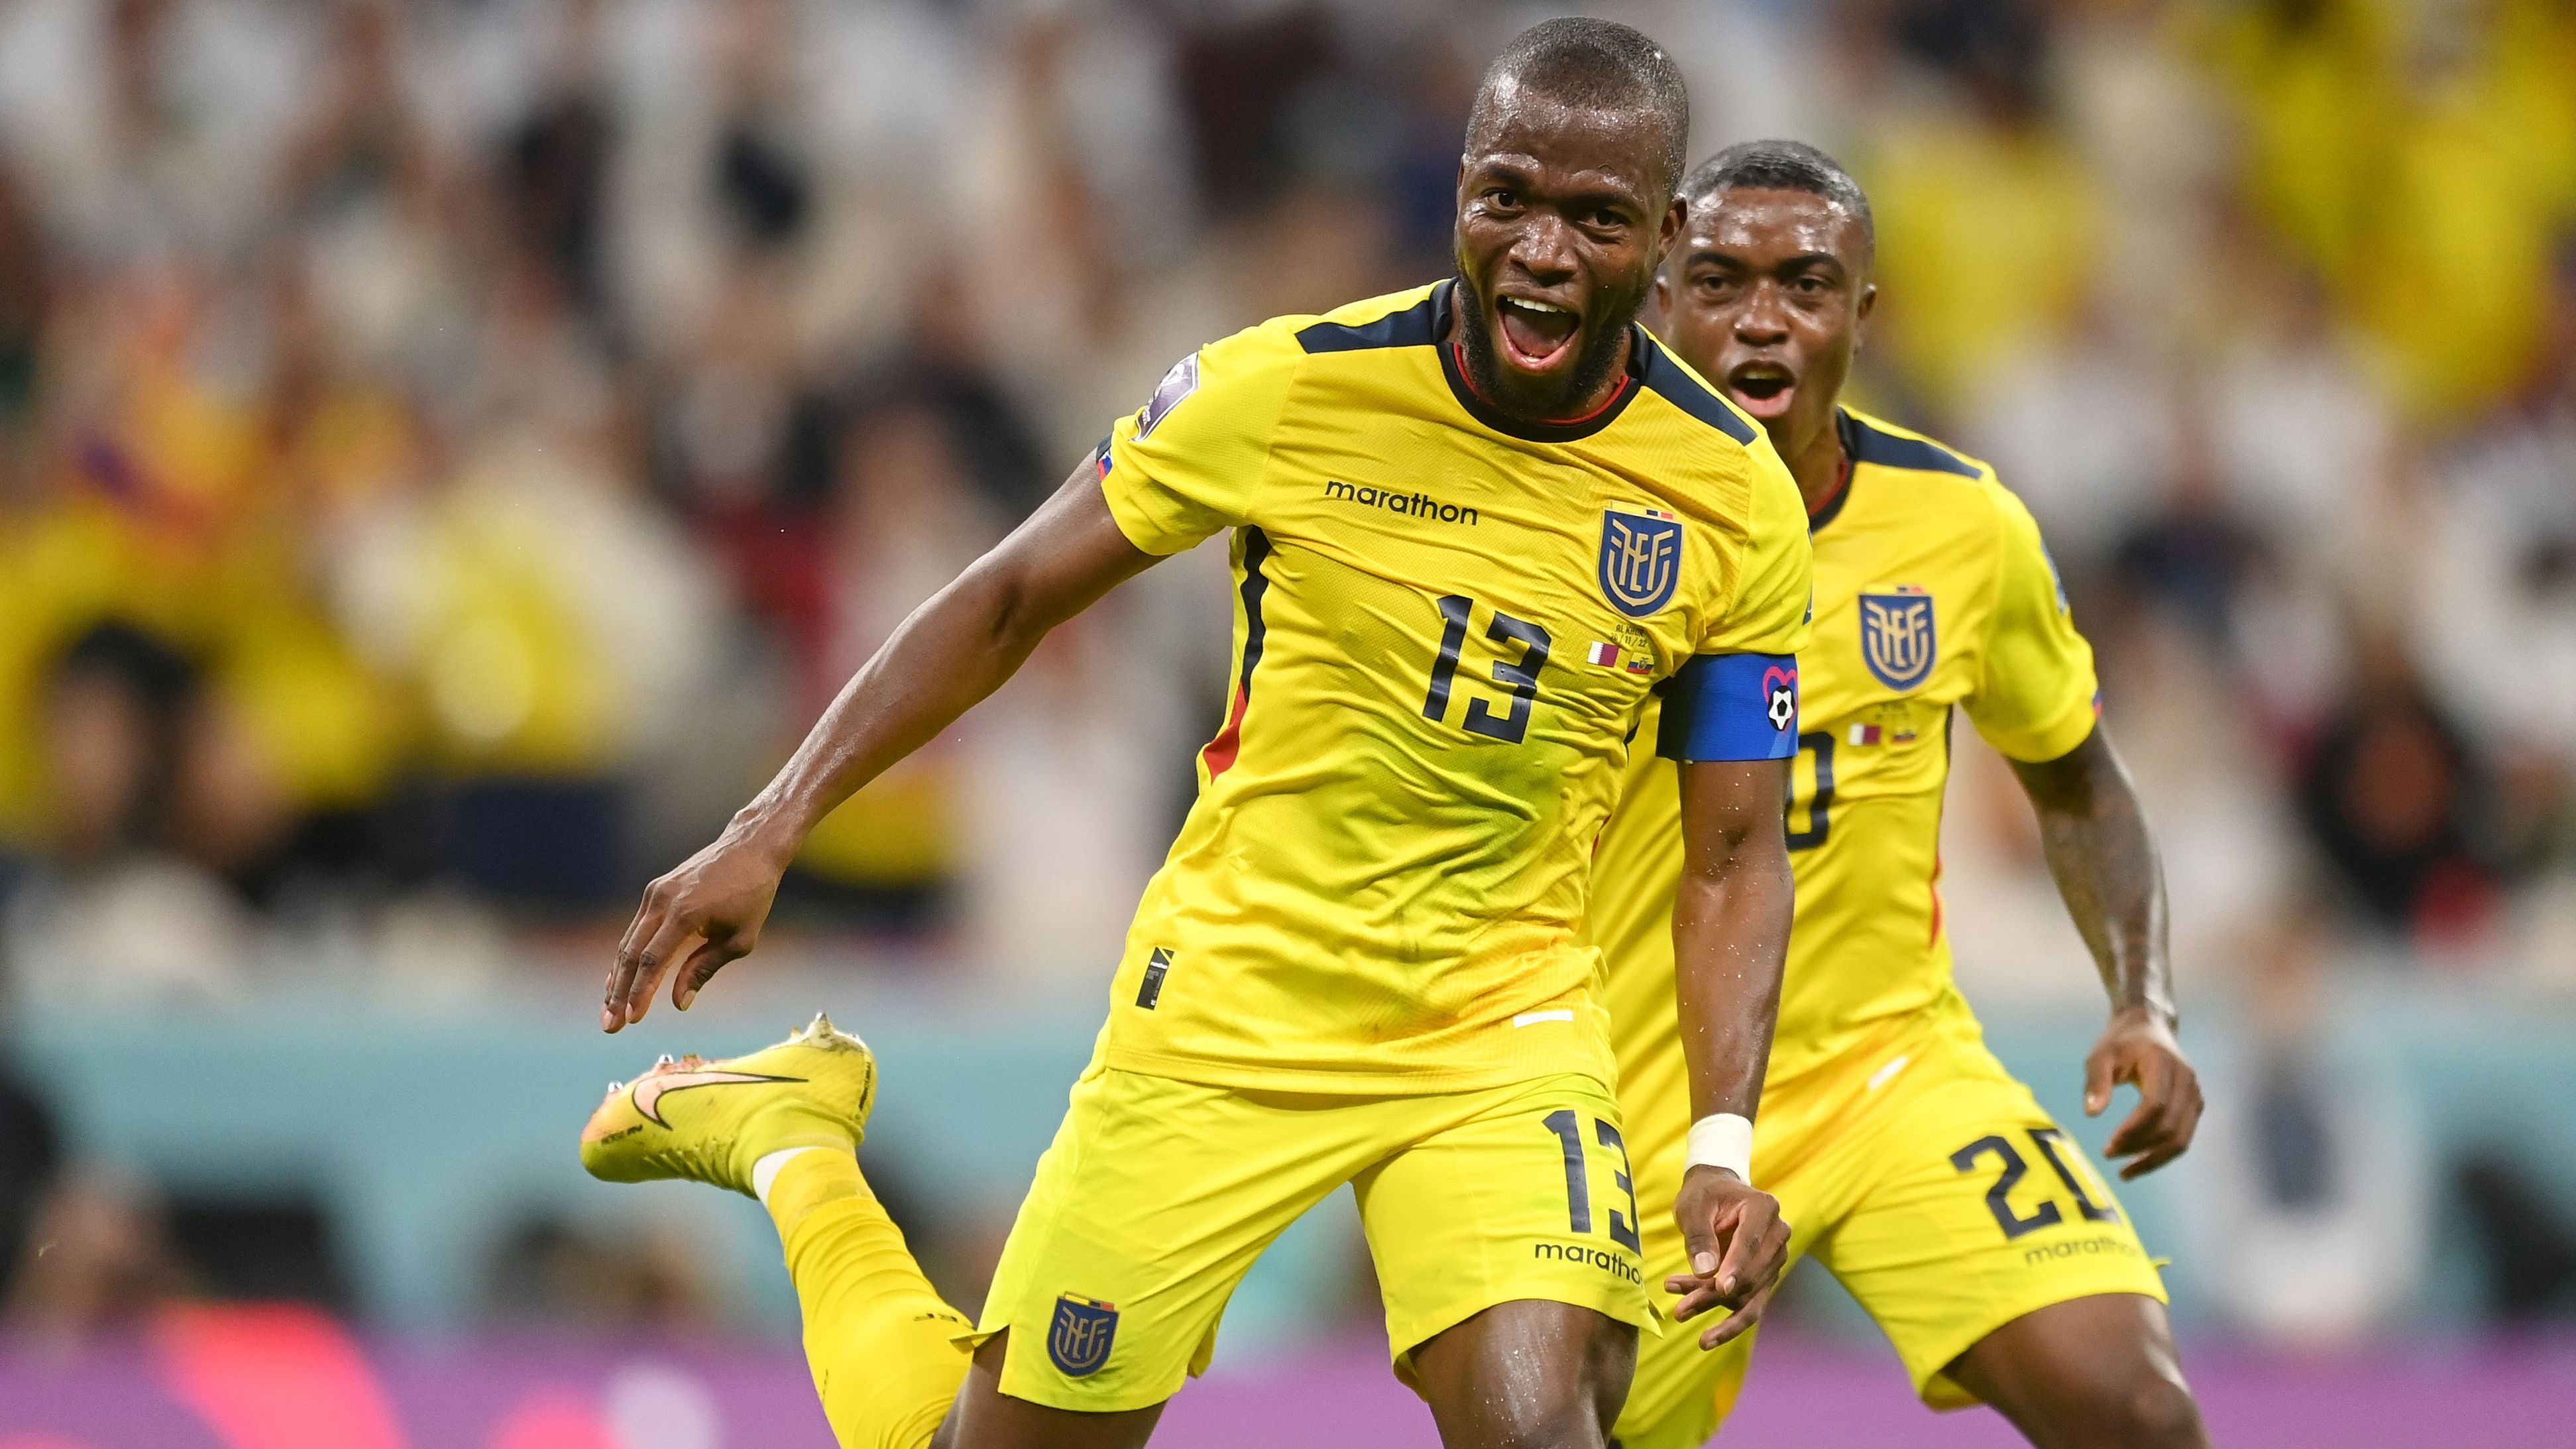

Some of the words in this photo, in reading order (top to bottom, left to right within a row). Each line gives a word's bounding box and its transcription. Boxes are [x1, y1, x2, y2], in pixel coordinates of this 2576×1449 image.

[1325, 481, 1478, 526] marathon
[1422, 594, 1552, 744] 13
[1616, 624, 1624, 632] AL
[1626, 626, 1644, 637] KHOR
[1541, 1109, 1643, 1258] 13
[1948, 1128, 2123, 1241] 20
[1534, 1243, 1644, 1288] maratho
